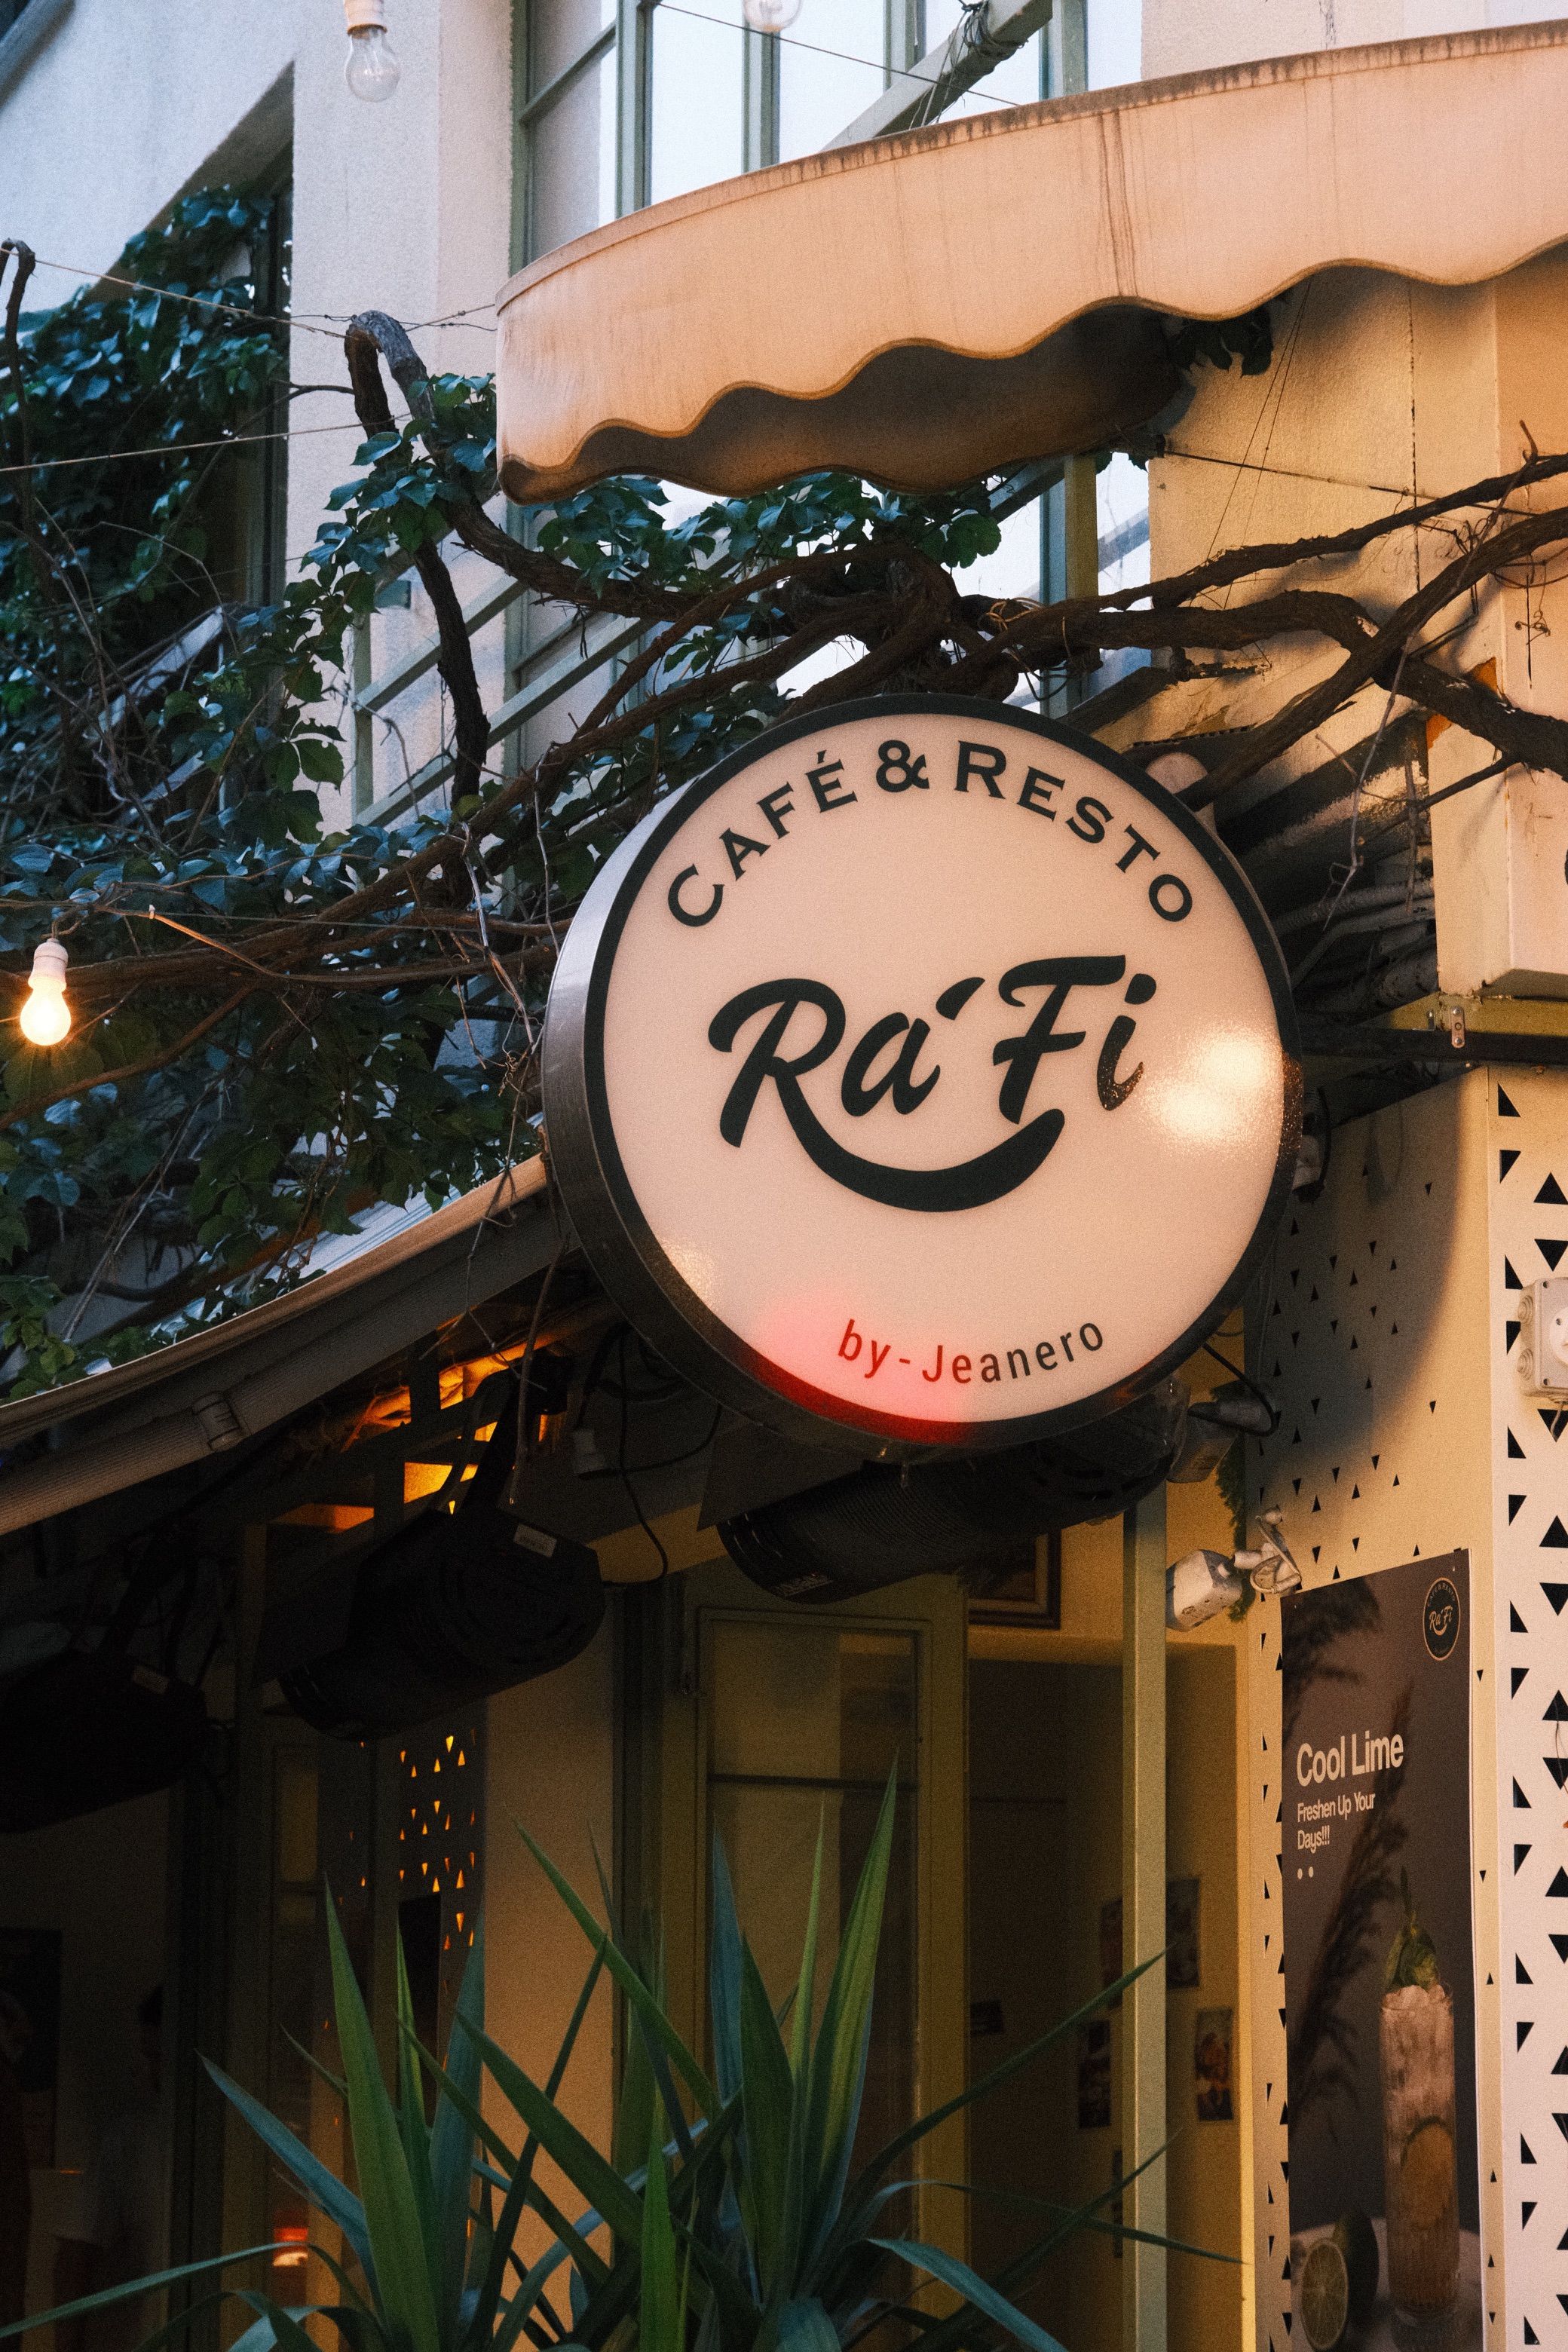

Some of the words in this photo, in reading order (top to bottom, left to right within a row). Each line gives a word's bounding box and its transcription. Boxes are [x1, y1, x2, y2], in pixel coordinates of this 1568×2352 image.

[668, 750, 857, 926] CAFÉ
[876, 740, 929, 793] &
[955, 741, 1192, 922] RESTO
[1297, 1735, 1346, 1787] Cool
[1352, 1730, 1404, 1776] Lime
[1297, 1799, 1336, 1822] Freshen
[1337, 1794, 1352, 1821] Up
[1353, 1791, 1376, 1811] Your
[1297, 1825, 1331, 1854] Days!!!
